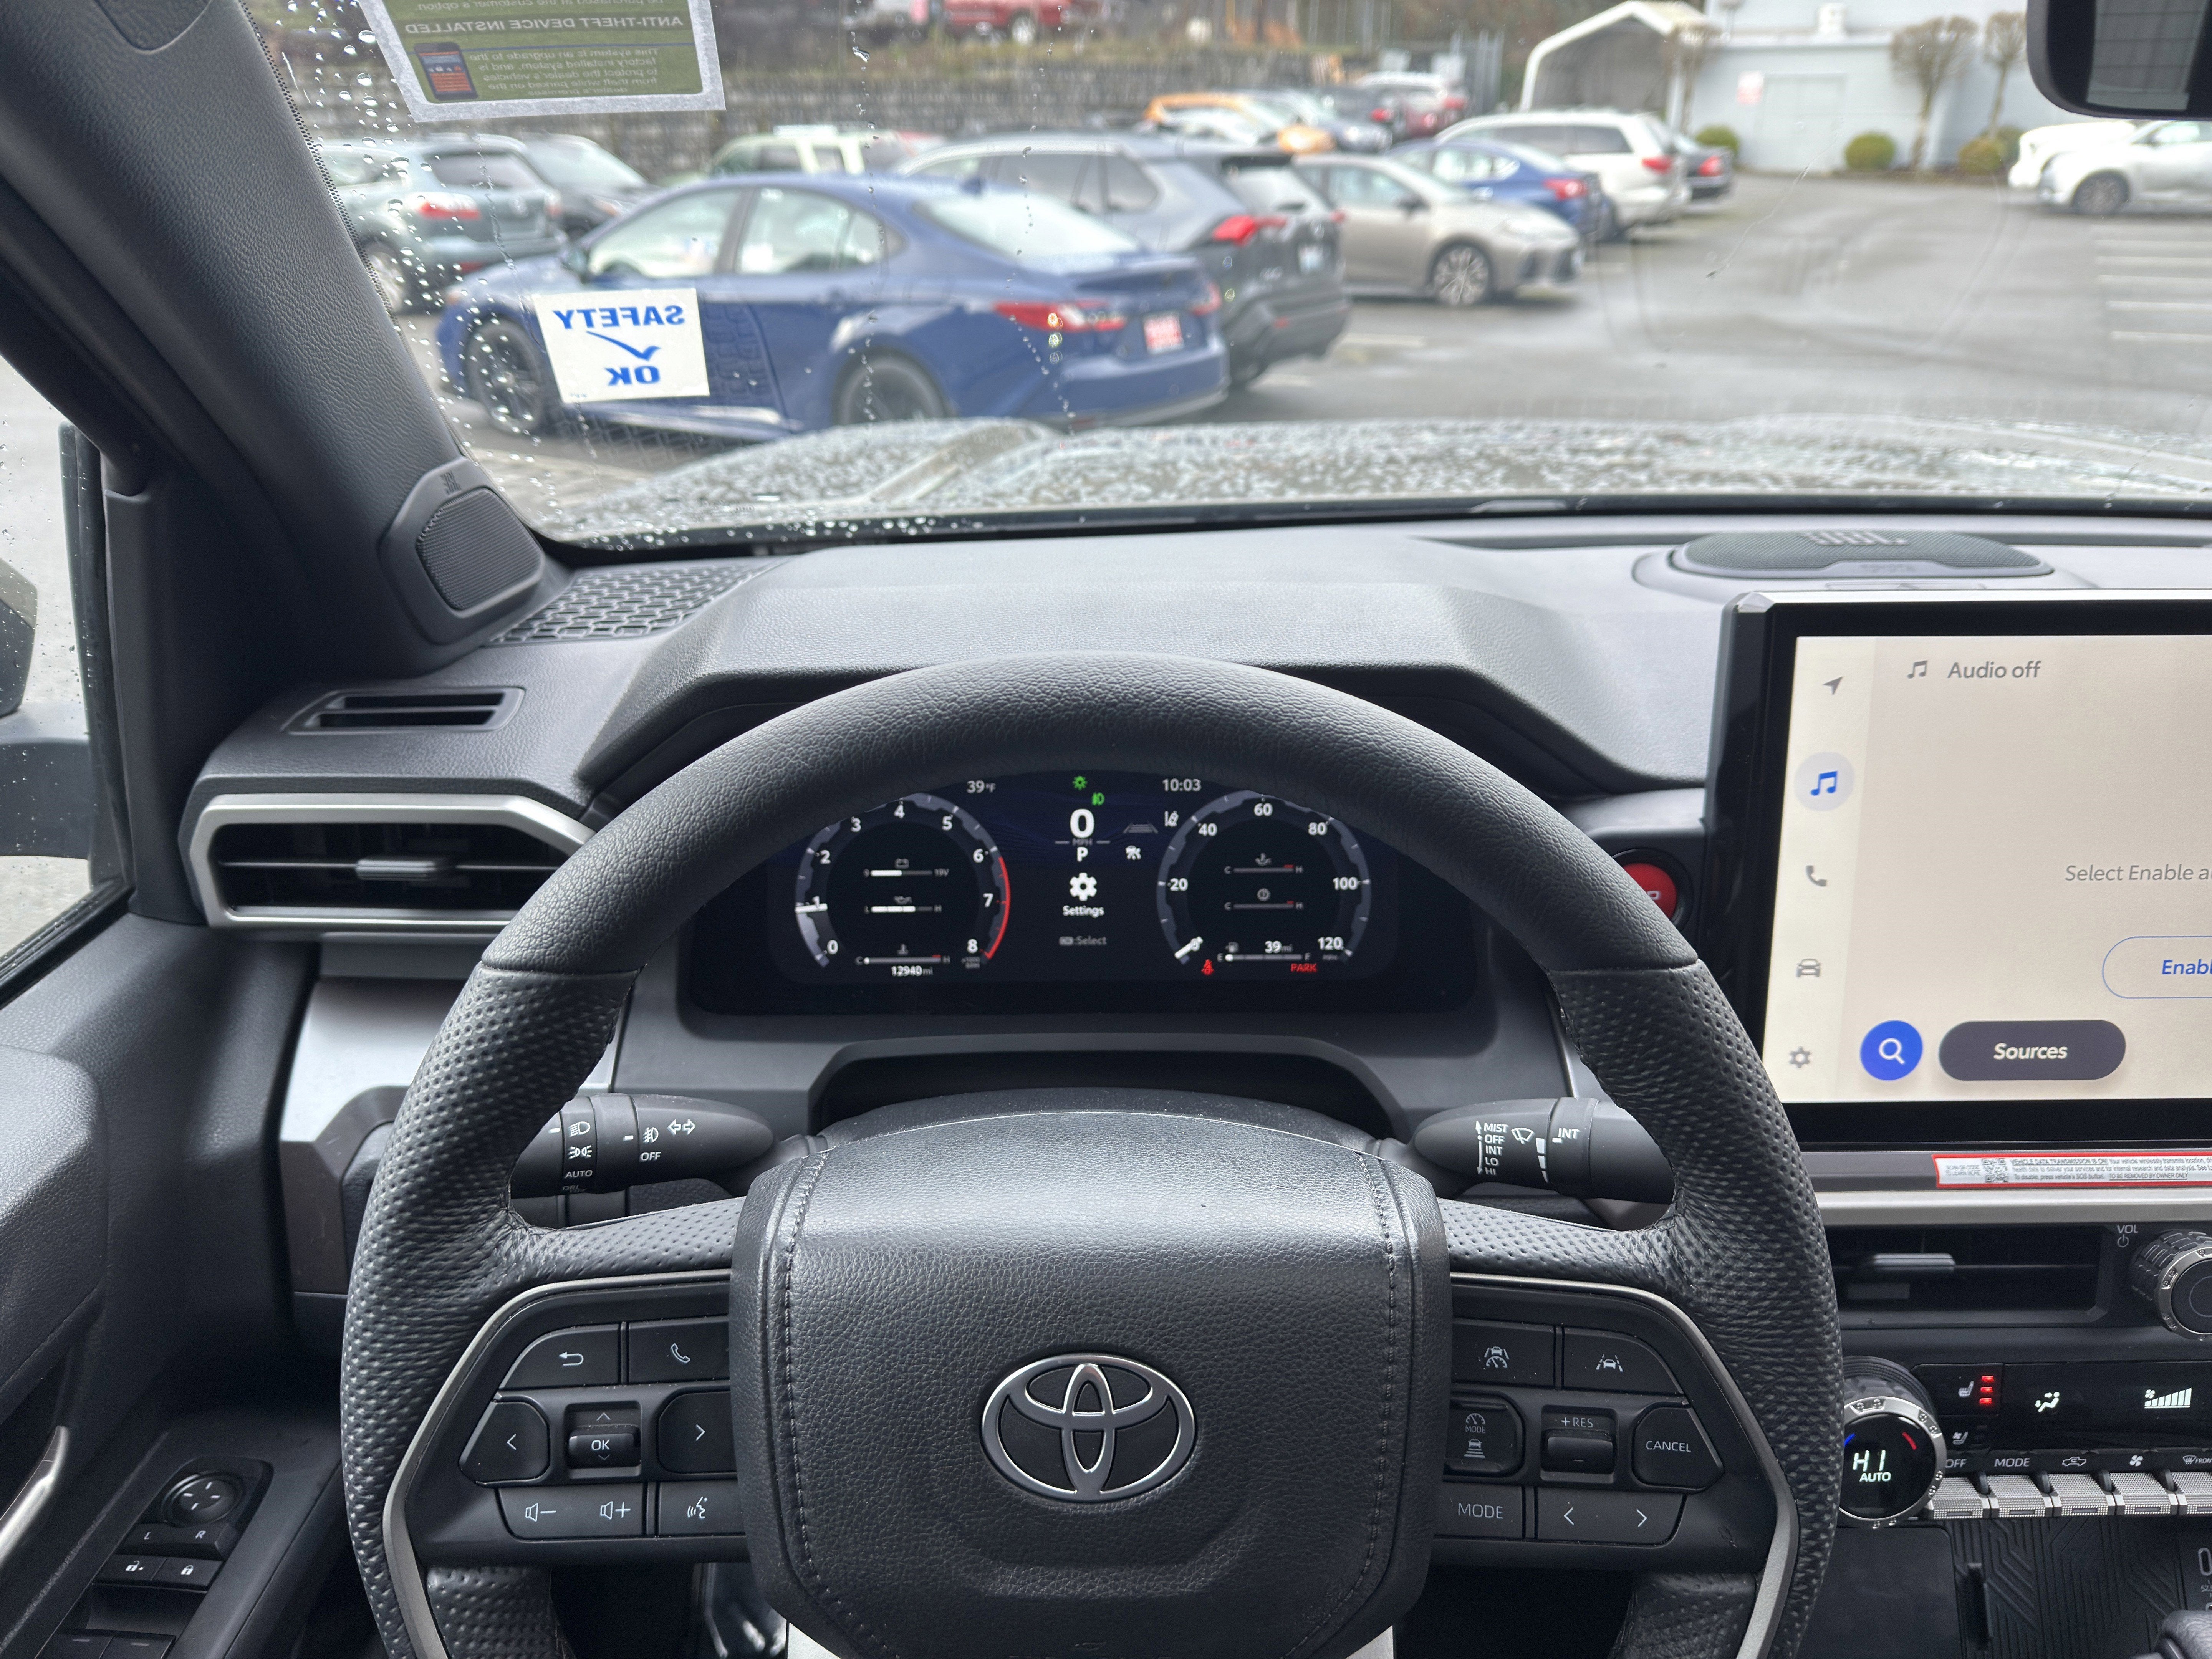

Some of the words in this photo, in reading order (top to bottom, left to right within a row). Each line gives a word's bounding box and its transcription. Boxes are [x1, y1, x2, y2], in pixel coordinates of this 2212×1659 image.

[1947, 661, 2007, 679] Audio
[2012, 660, 2041, 679] off
[1162, 778, 1202, 792] 10:03
[893, 805, 906, 819] 4
[1253, 803, 1273, 817] 60
[850, 818, 861, 833] 3
[942, 816, 953, 831] 5
[1070, 809, 1095, 838] 0
[1198, 823, 1217, 836] 40
[1308, 822, 1327, 836] 80
[820, 850, 831, 865] 2
[973, 848, 984, 863] 6
[1077, 846, 1089, 862] P
[1295, 866, 1303, 874] H
[2065, 864, 2124, 882] Select
[2128, 864, 2194, 882] Enable
[2199, 868, 2212, 881] a
[1169, 878, 1188, 891] 20
[1332, 877, 1359, 890] 100
[812, 896, 820, 908] 1
[983, 892, 994, 908] 7
[1295, 902, 1303, 910] H
[934, 905, 942, 913] H
[1062, 906, 1105, 918] Settings
[827, 939, 839, 954] 0
[967, 938, 978, 954] 8
[1317, 937, 1343, 950] 120
[1291, 963, 1317, 973] PARK
[1993, 1043, 2068, 1061] Sources
[1483, 1123, 1508, 1133] MIST
[1558, 1128, 1580, 1139] INT
[1485, 1134, 1505, 1145] OFF
[639, 1151, 661, 1162] OFF
[1485, 1145, 1502, 1156] INT
[1485, 1156, 1499, 1166] LO
[564, 1169, 593, 1179] AUTO
[1485, 1167, 1497, 1176] HI
[2116, 1224, 2138, 1234] VOL
[1465, 1425, 1486, 1434] MODE
[591, 1439, 611, 1451] OK
[1645, 1440, 1692, 1453] CANCEL
[1945, 1459, 1967, 1469] OFF
[1994, 1458, 2030, 1468] MODE
[1859, 1472, 1892, 1483] AUTO
[1457, 1502, 1503, 1520] MODE
[144, 1532, 151, 1540] L
[195, 1530, 207, 1539] R
